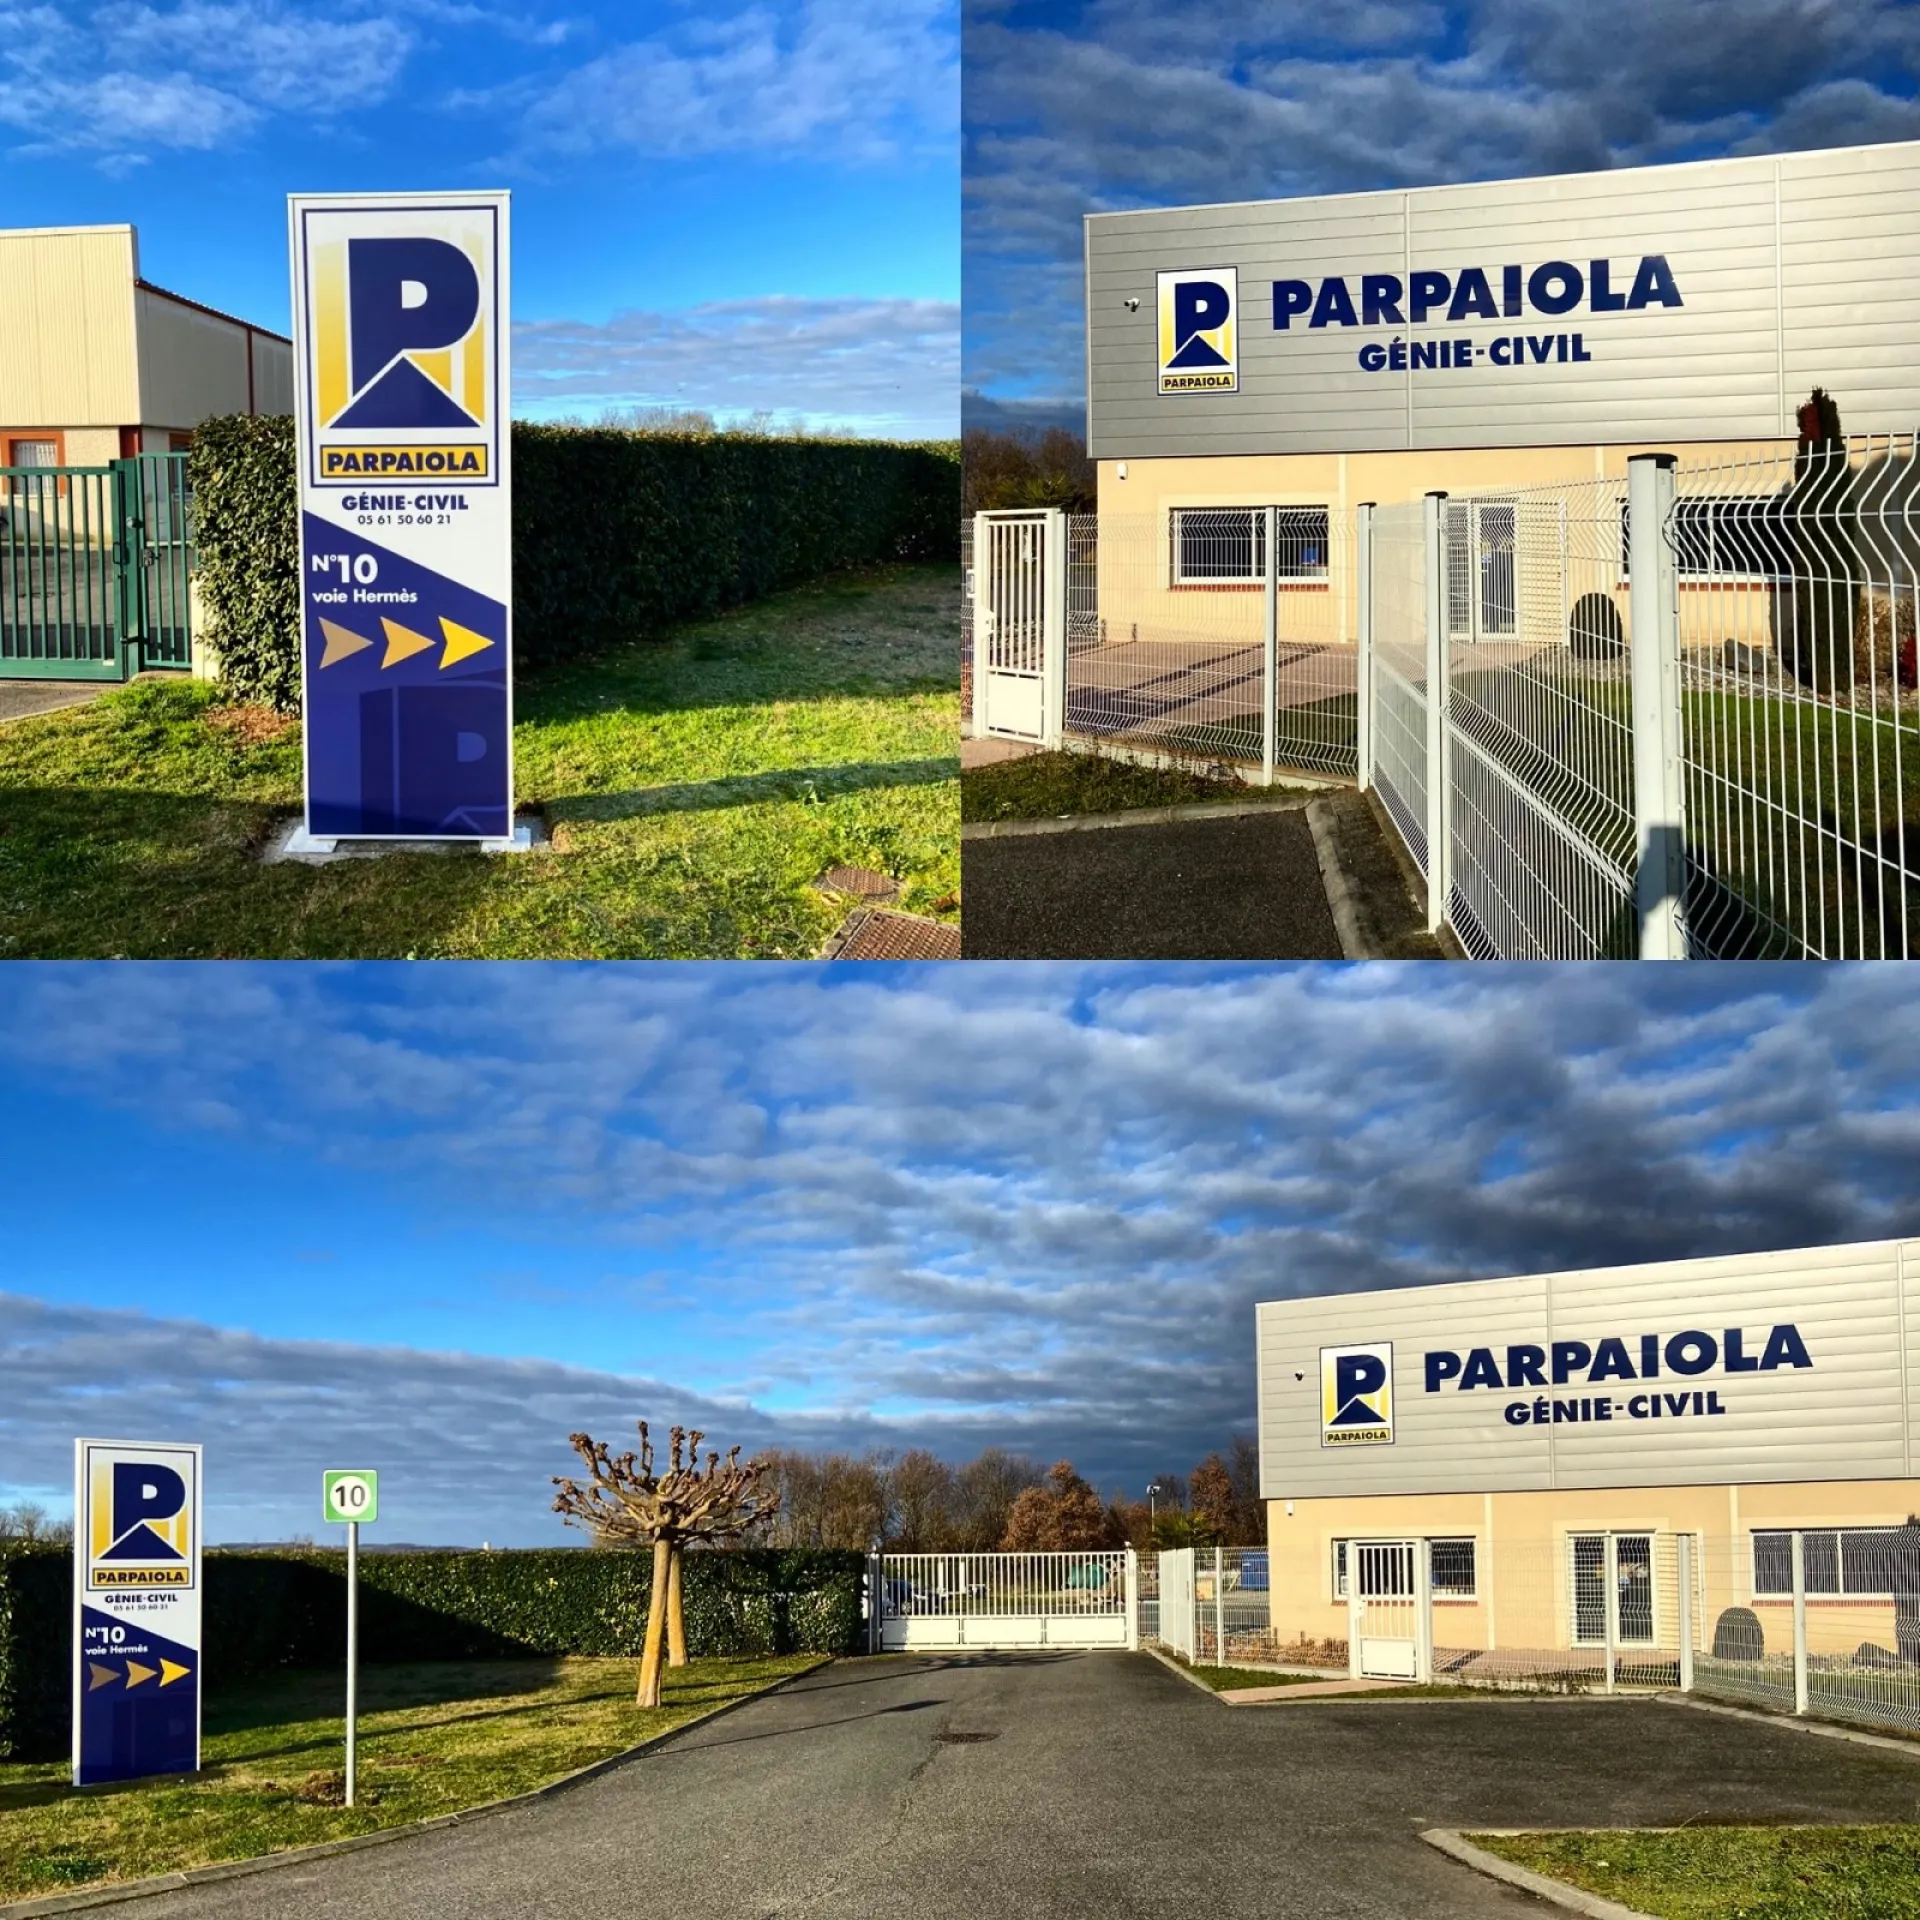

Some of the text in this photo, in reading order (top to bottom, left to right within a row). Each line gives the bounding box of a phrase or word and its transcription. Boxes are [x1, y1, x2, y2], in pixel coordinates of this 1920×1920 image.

[1272, 254, 1684, 330] PARPAIOLA
[1358, 333, 1592, 372] GÉNIE-CIVIL
[1164, 376, 1231, 388] PARPAIOLA
[326, 452, 480, 472] PARPAIOLA
[341, 491, 469, 511] GÉNIE-CIVIL
[357, 514, 451, 525] 05 61 50 60 21
[312, 588, 418, 603] voie Hermès
[1424, 1323, 1814, 1392] PARPAIOLA
[1504, 1391, 1726, 1426] GÉNIE-CIVIL
[1327, 1431, 1387, 1442] PARPAIOLA
[335, 1485, 366, 1507] 10
[96, 1571, 185, 1583] PARPAIOLA
